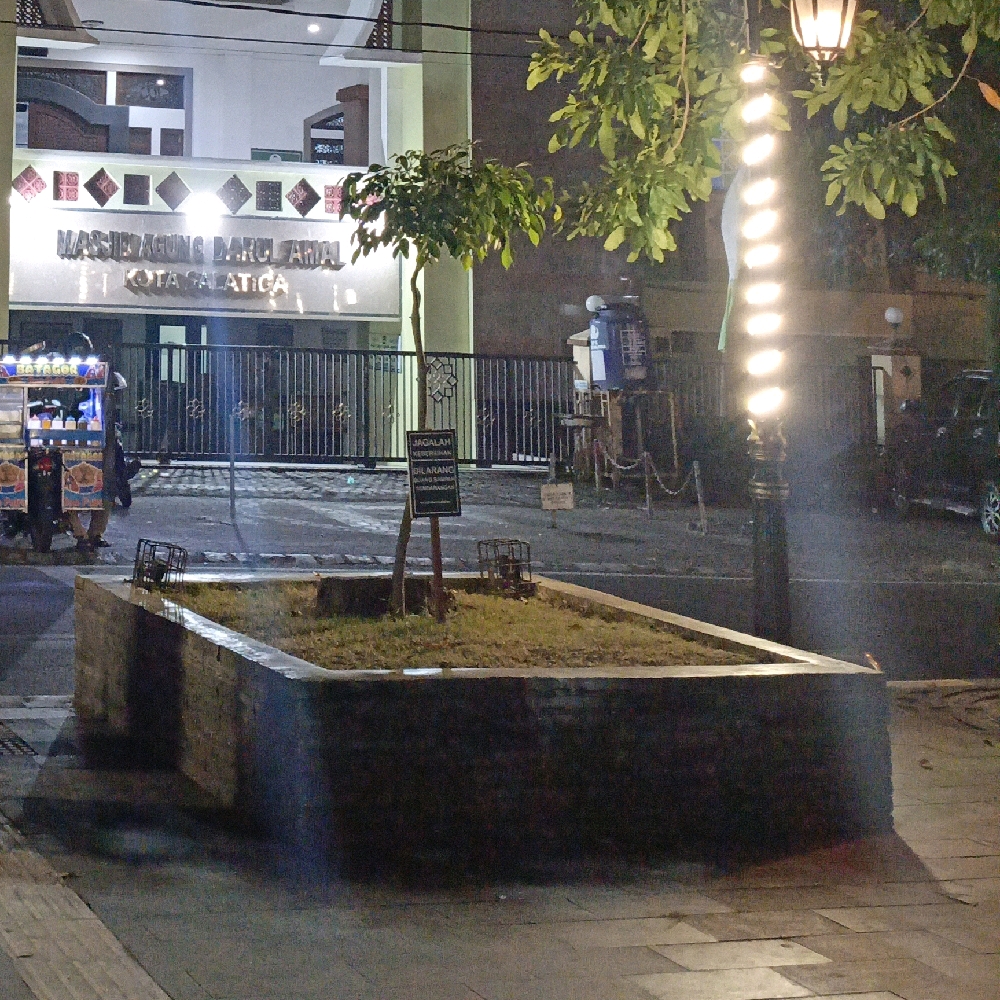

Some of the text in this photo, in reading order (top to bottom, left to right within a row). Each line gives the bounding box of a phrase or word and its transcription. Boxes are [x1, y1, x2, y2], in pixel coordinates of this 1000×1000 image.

[139, 233, 204, 264] AGUNG
[212, 236, 280, 264] DARUL
[123, 268, 289, 294] KOTA SALATIGA
[16, 364, 78, 375] BATAGOR
[412, 438, 451, 447] JAGALAH
[413, 466, 454, 475] DILARANG
